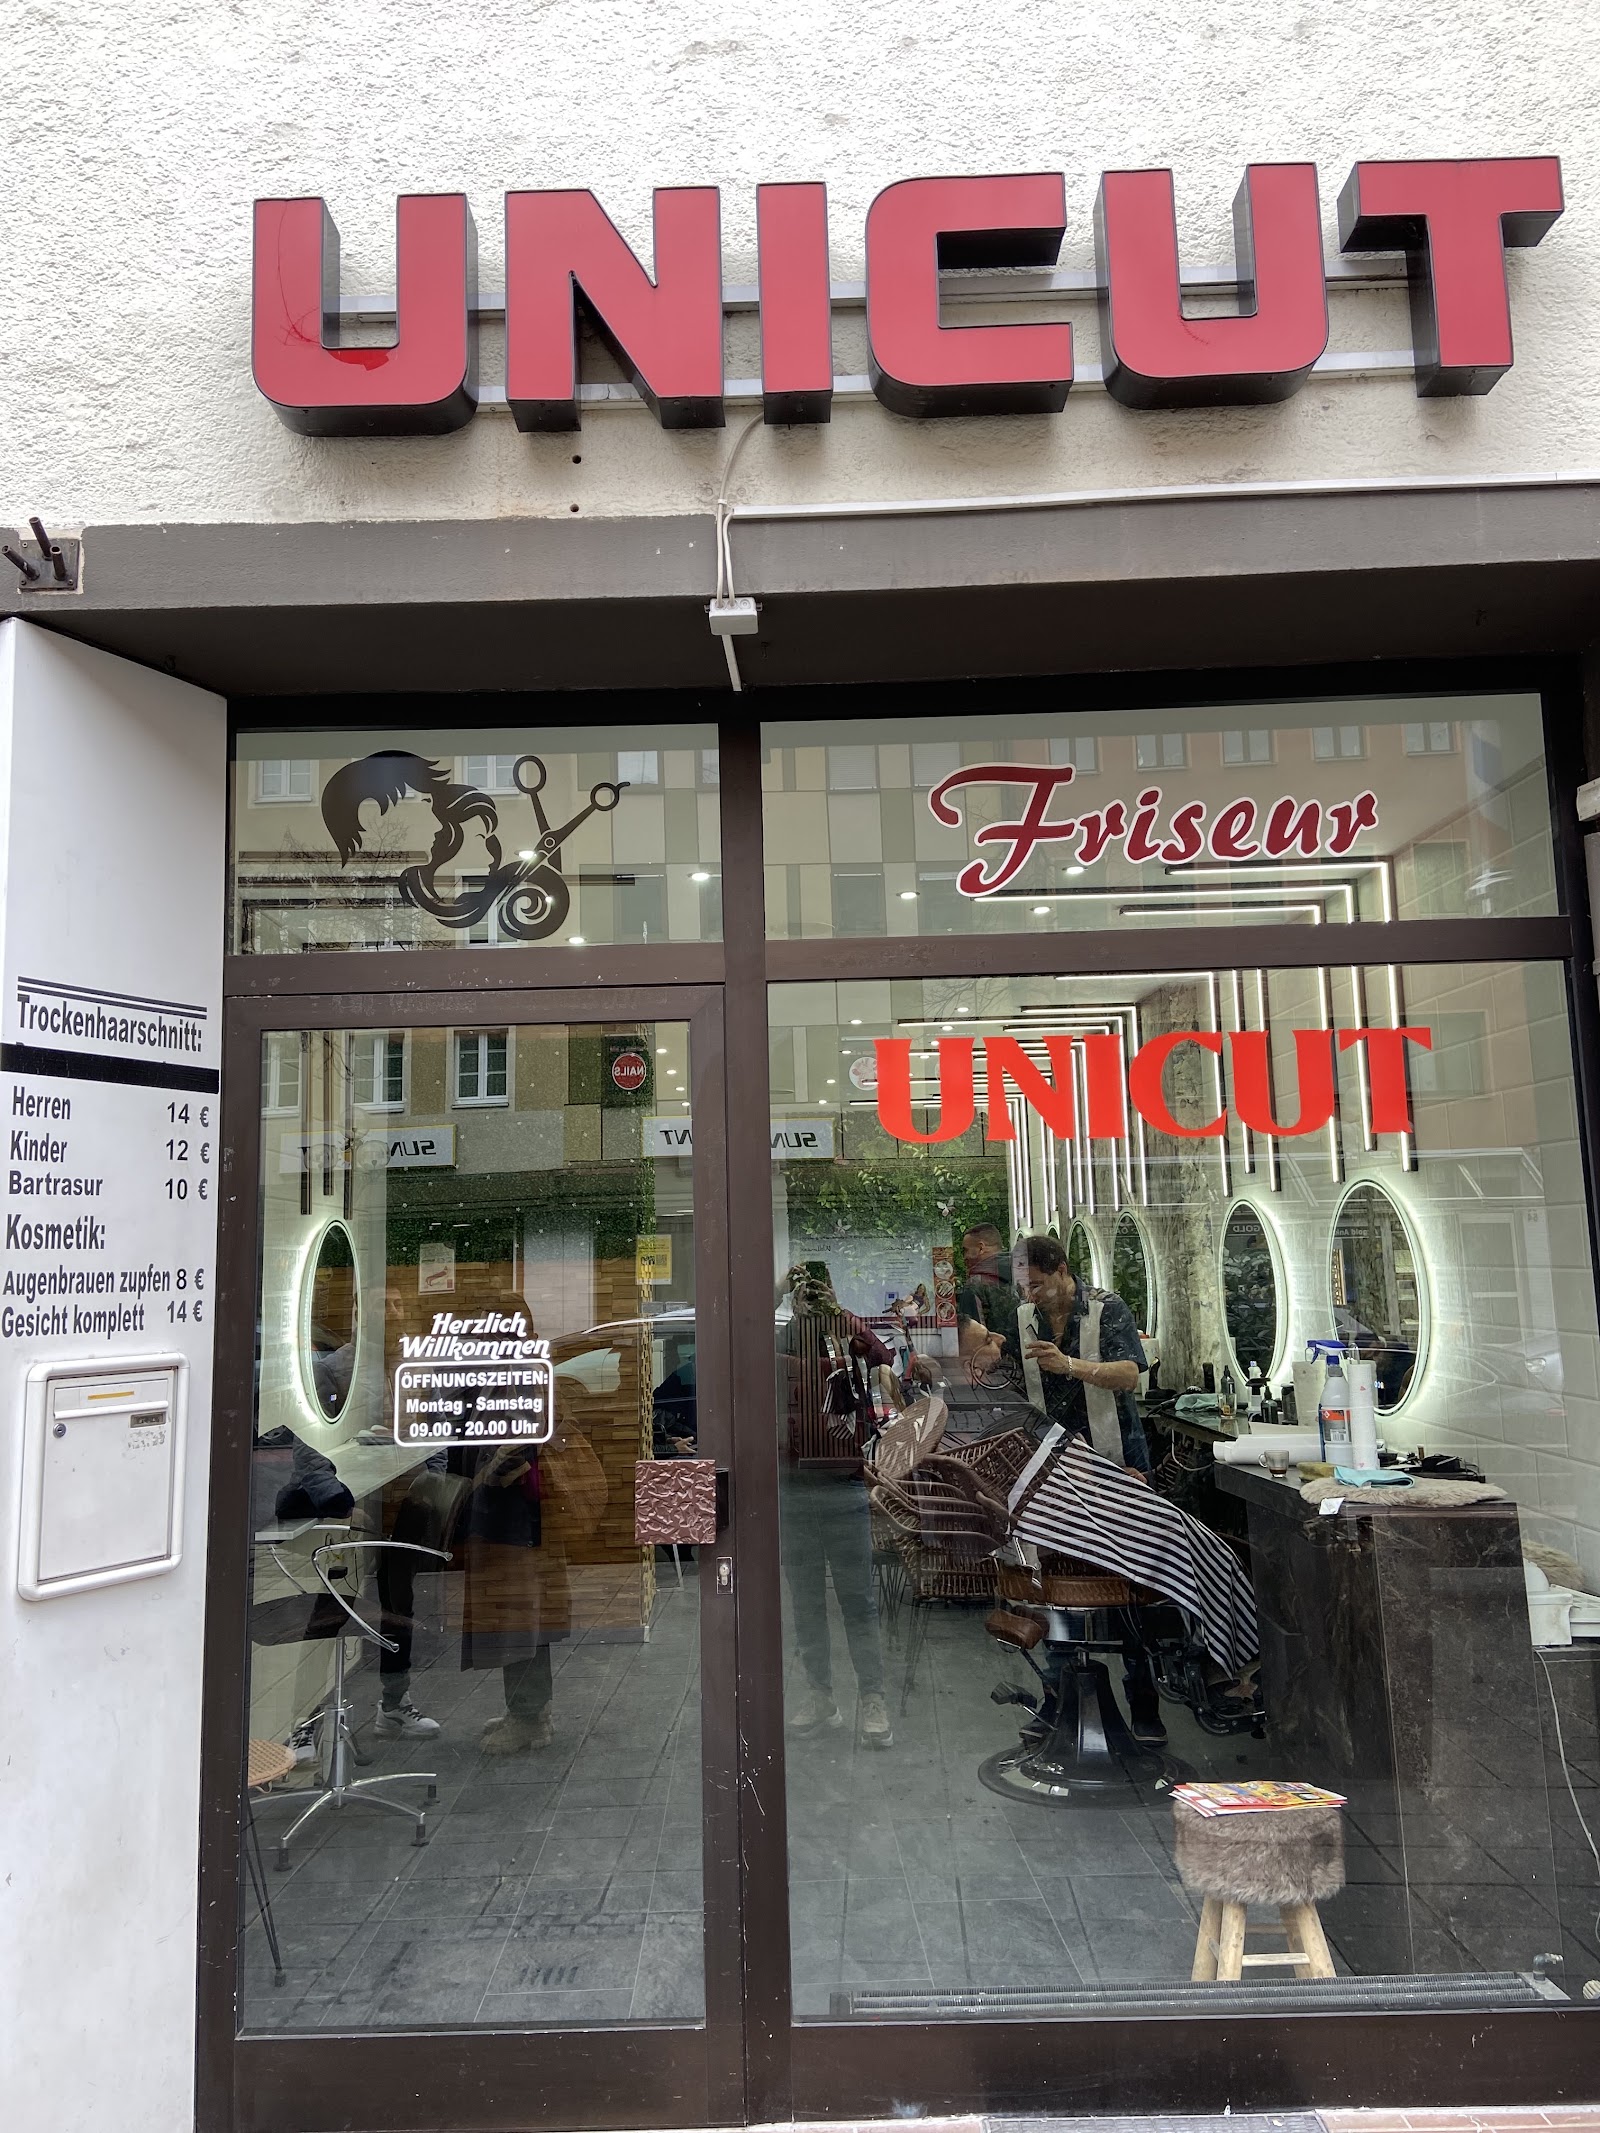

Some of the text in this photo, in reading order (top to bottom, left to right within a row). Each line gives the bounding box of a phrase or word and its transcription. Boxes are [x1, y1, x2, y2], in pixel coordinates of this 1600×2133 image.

[252, 156, 1564, 436] UNICUT
[928, 763, 1378, 897] Friseur
[17, 993, 202, 1053] Trockenhaarschnitt:
[873, 1026, 1432, 1143] UNICUT
[12, 1085, 209, 1128] Herren 14 €
[10, 1129, 210, 1164] Kinder 12 €
[9, 1170, 208, 1200] Bartrasur 10 €
[6, 1213, 106, 1250] Kosmetik:
[3, 1263, 204, 1304] Augenbrauen zupfen 8 €
[1, 1300, 203, 1340] Gesicht komplett 14 €
[431, 1311, 527, 1338] Herzlich
[399, 1336, 551, 1361] Willkommen
[401, 1370, 549, 1389] ÖFFNUNGSZEITEN:
[406, 1398, 463, 1415] Montag
[476, 1396, 543, 1412] Samstag
[409, 1422, 452, 1437] 09.00
[465, 1421, 507, 1436] 20.00
[511, 1420, 539, 1434] Uhr
